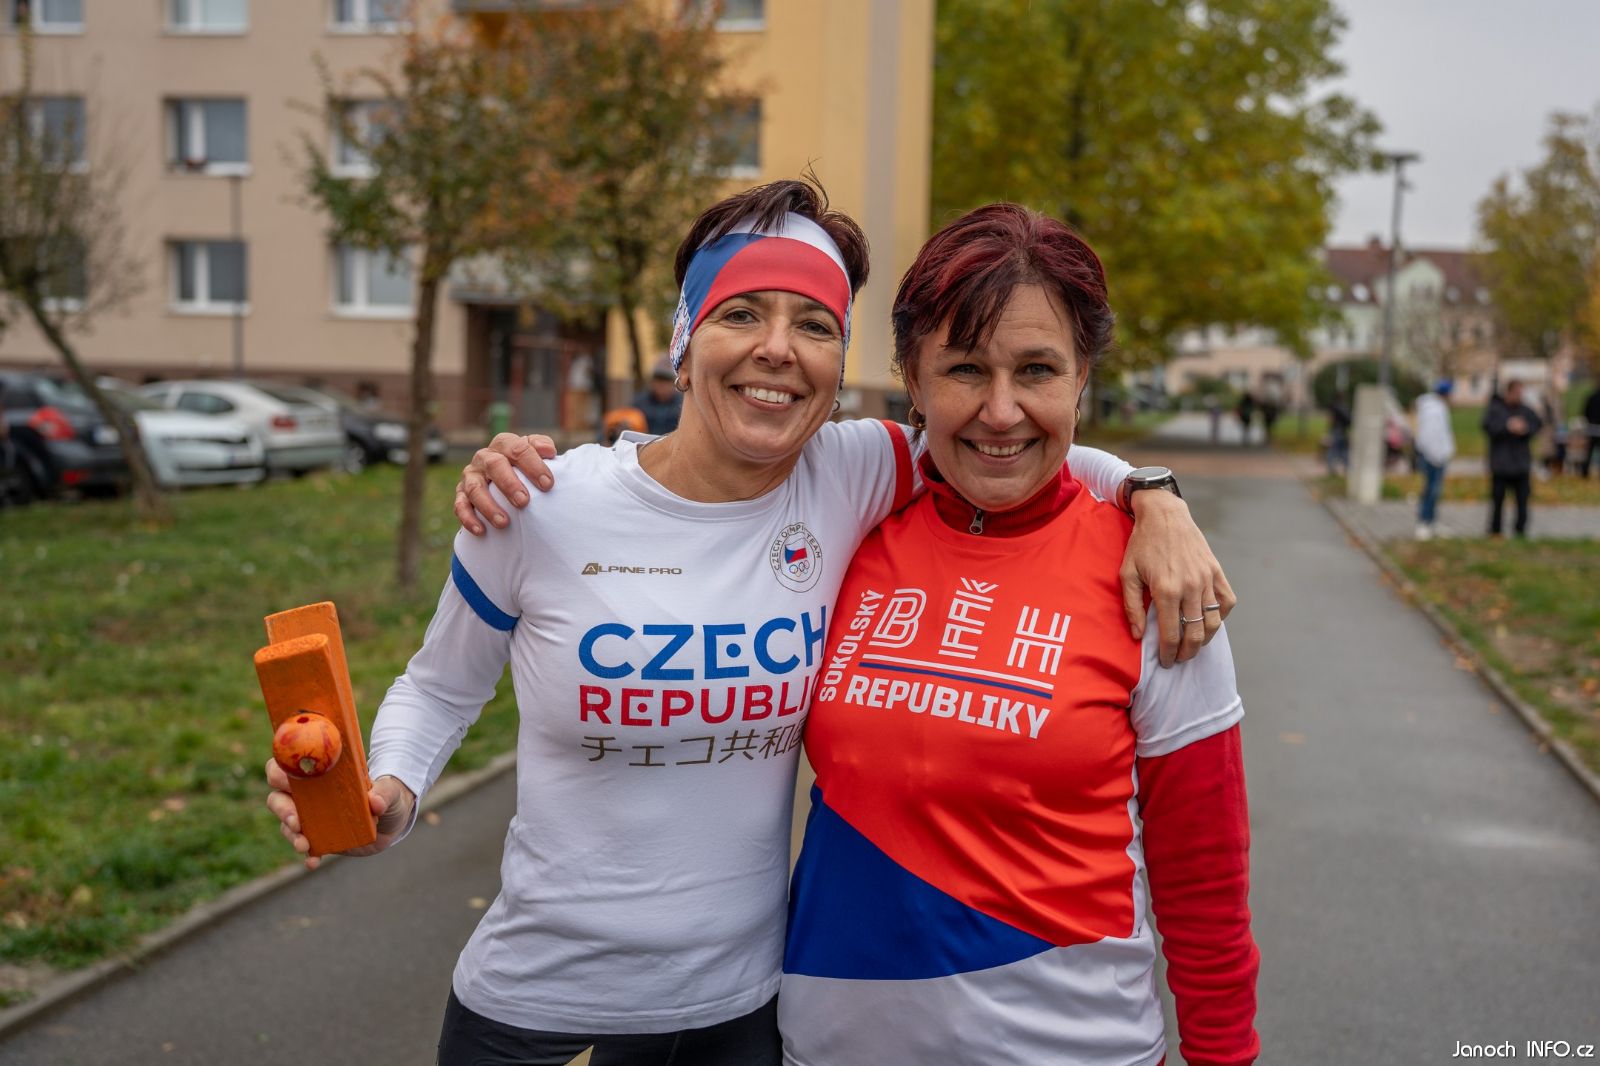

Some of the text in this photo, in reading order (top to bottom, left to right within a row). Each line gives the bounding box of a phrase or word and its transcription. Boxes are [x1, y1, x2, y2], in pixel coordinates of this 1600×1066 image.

[581, 562, 683, 576] ALPINE PRO
[771, 540, 783, 571] CZECH
[806, 533, 821, 559] TEAM
[578, 605, 827, 681] CZECH
[819, 589, 886, 703] SOKOLSKÝ
[844, 675, 1051, 740] REPUBLIKY
